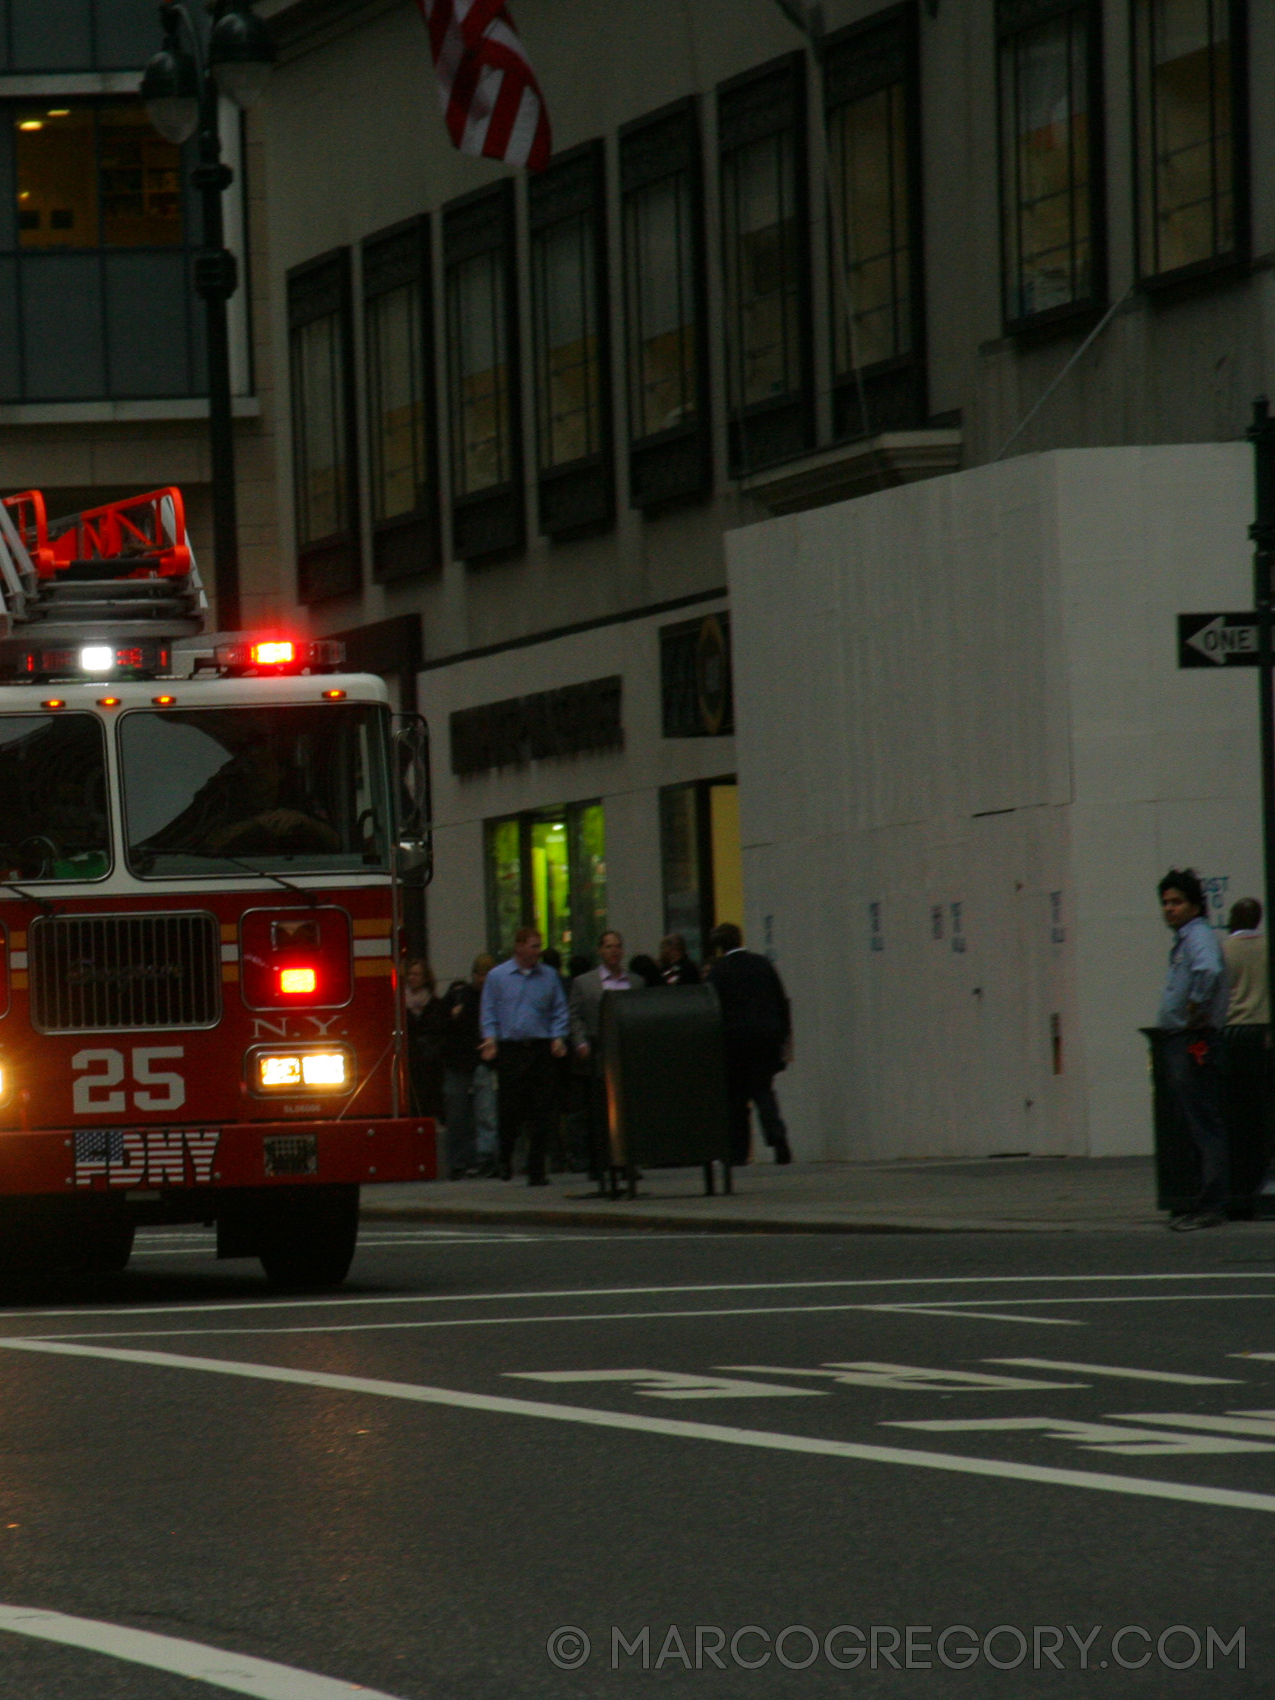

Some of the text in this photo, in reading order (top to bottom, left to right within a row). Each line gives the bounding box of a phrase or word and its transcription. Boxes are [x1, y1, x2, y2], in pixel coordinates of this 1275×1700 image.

[1205, 630, 1252, 651] ONE
[249, 1014, 349, 1039] N.Y.
[71, 1046, 186, 1114] 25
[75, 1130, 221, 1187] FDNY
